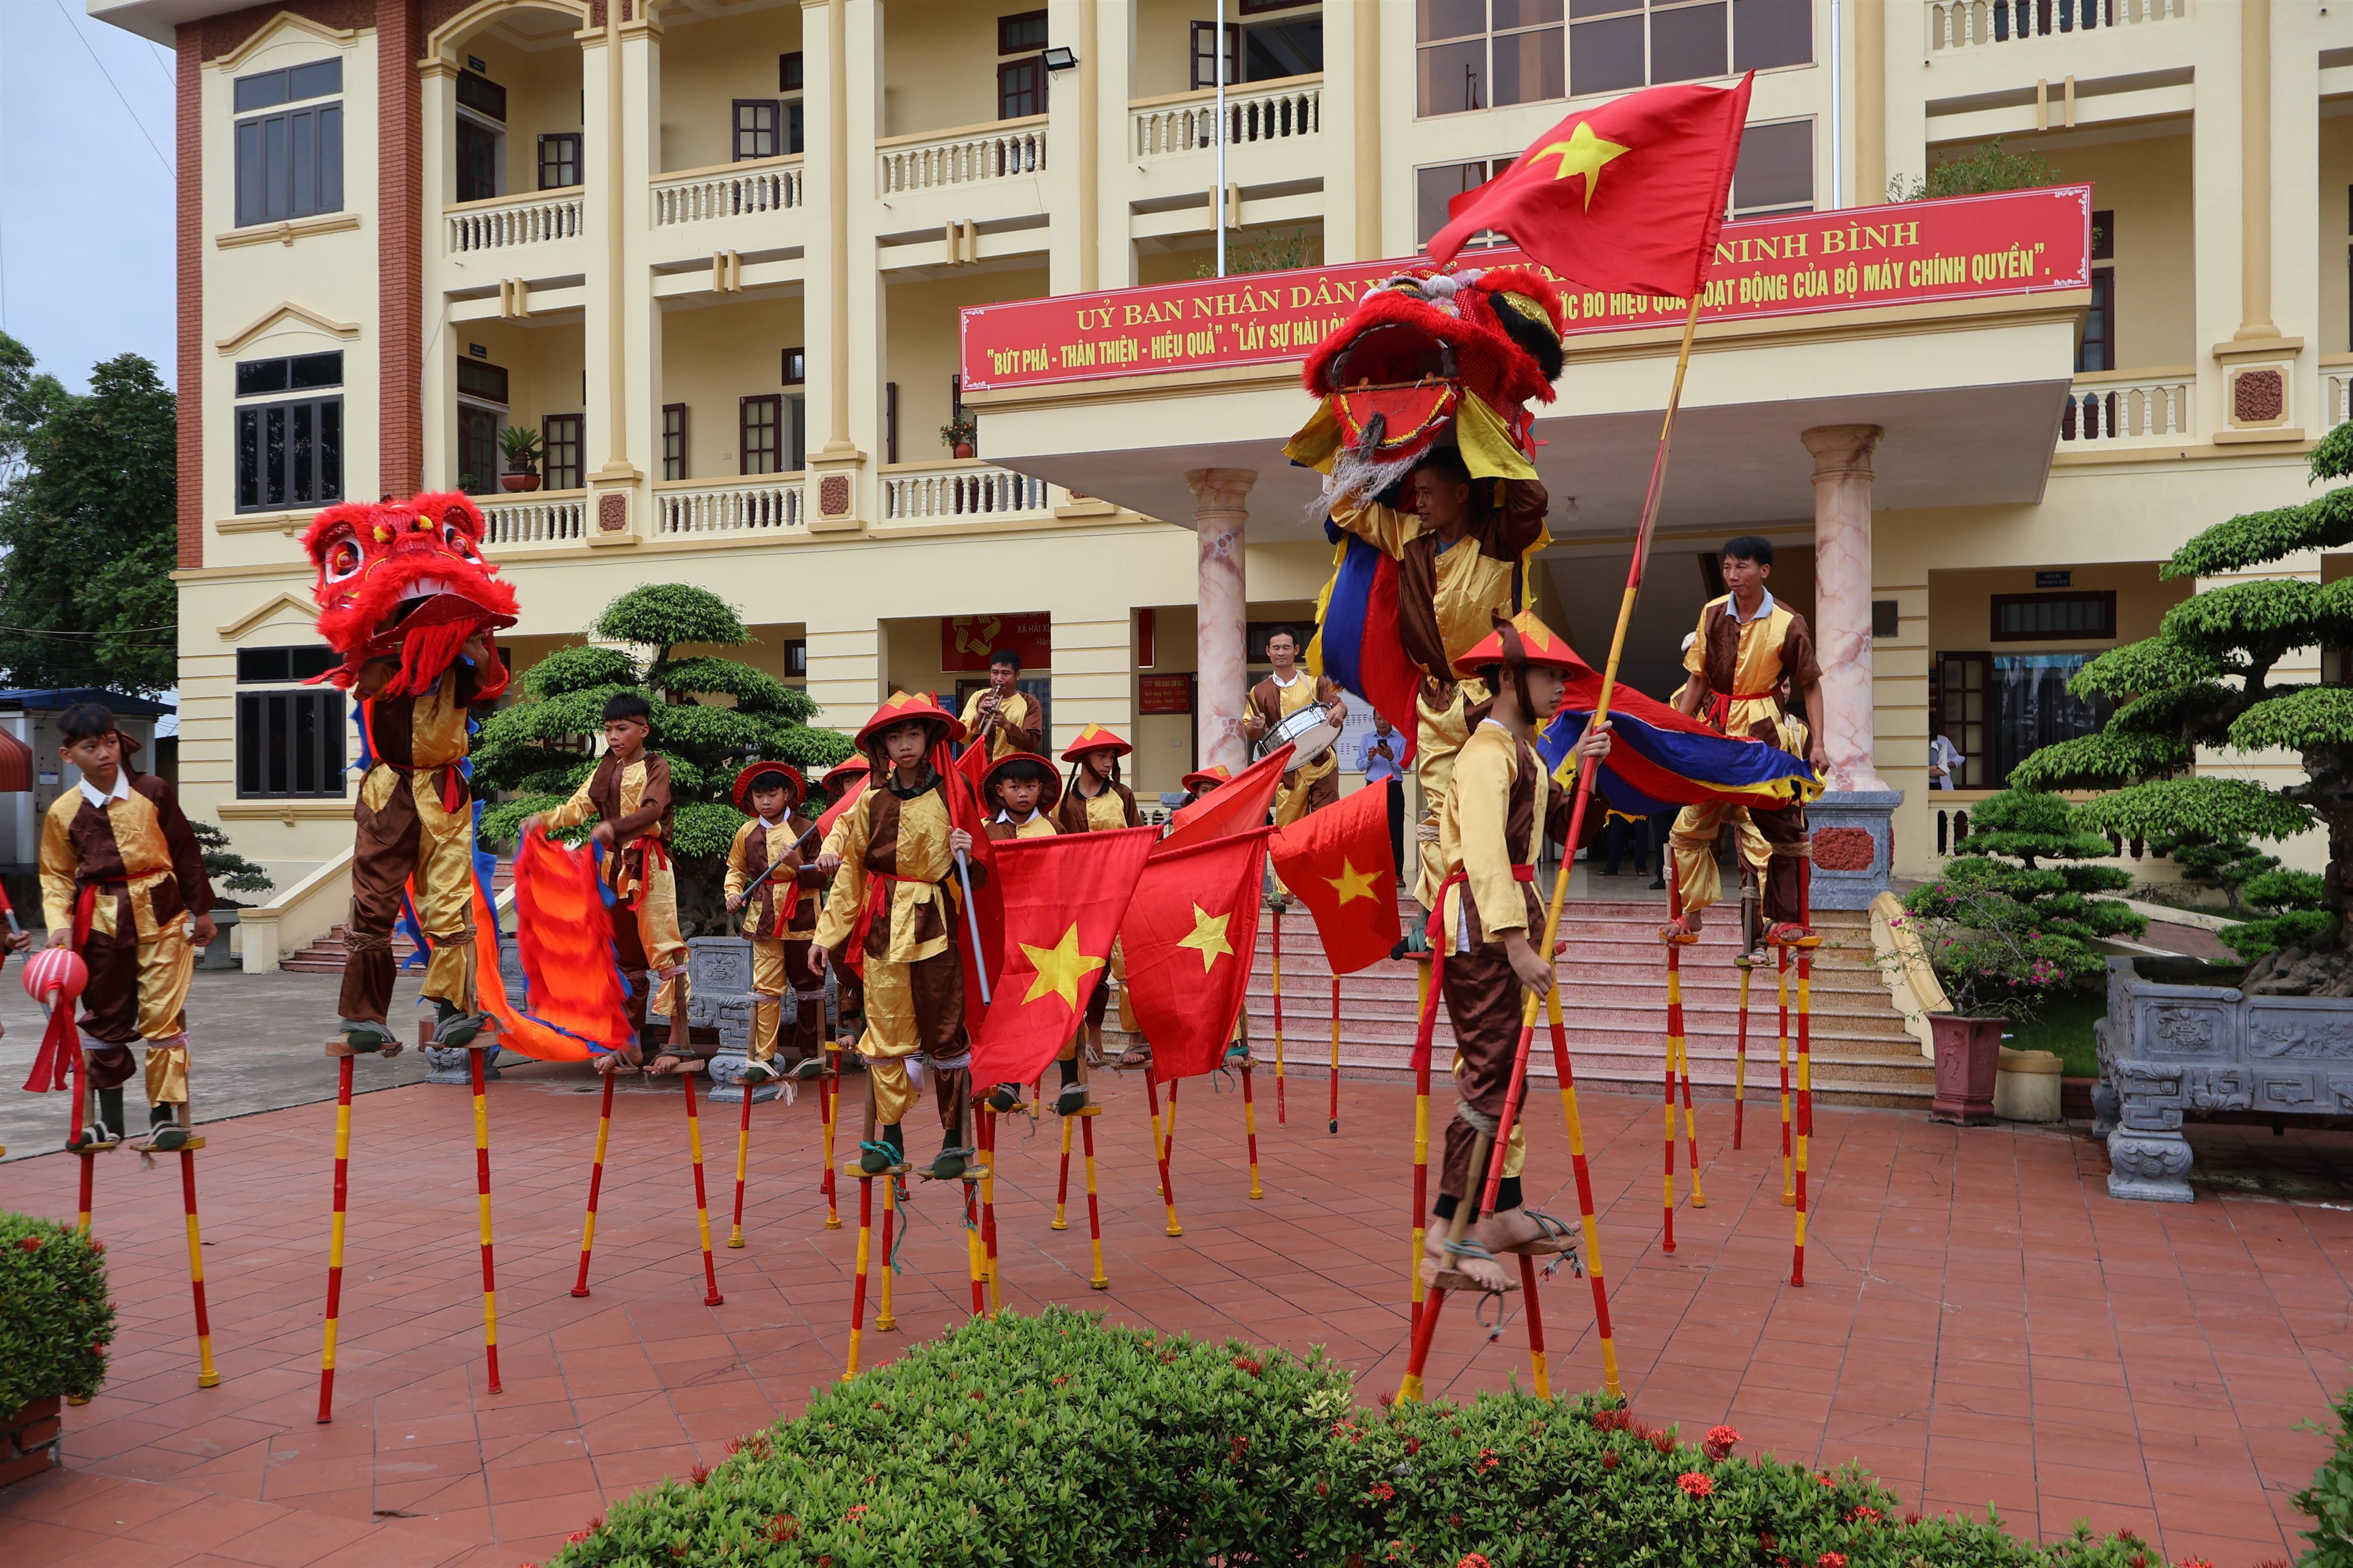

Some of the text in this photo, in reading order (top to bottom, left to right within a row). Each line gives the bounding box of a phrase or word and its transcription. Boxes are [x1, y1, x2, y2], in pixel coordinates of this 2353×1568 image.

[1022, 343, 1049, 372] PHÁ
[1060, 339, 1096, 368] THÂN
[1098, 334, 1138, 368] THIỆN
[1151, 330, 1183, 363] HIỆU
[1270, 320, 1291, 352] SỰ
[1293, 316, 1318, 346] HÀI
[1583, 291, 1605, 318] ĐO
[1699, 279, 1735, 312] OẠT
[1739, 271, 1788, 308] ĐỘNG
[1793, 262, 1829, 299] CỦA
[1834, 261, 1858, 299] BỘ
[1863, 257, 1904, 292] MÁY
[1909, 252, 1966, 287] CHÍNH
[1076, 298, 1116, 330] UỶ
[1123, 299, 1184, 326] BAN
[1192, 285, 1281, 318] NHÂN
[1289, 277, 1357, 309] DÂN
[1711, 233, 1809, 265] NINH
[1820, 221, 1920, 254] BÌNH
